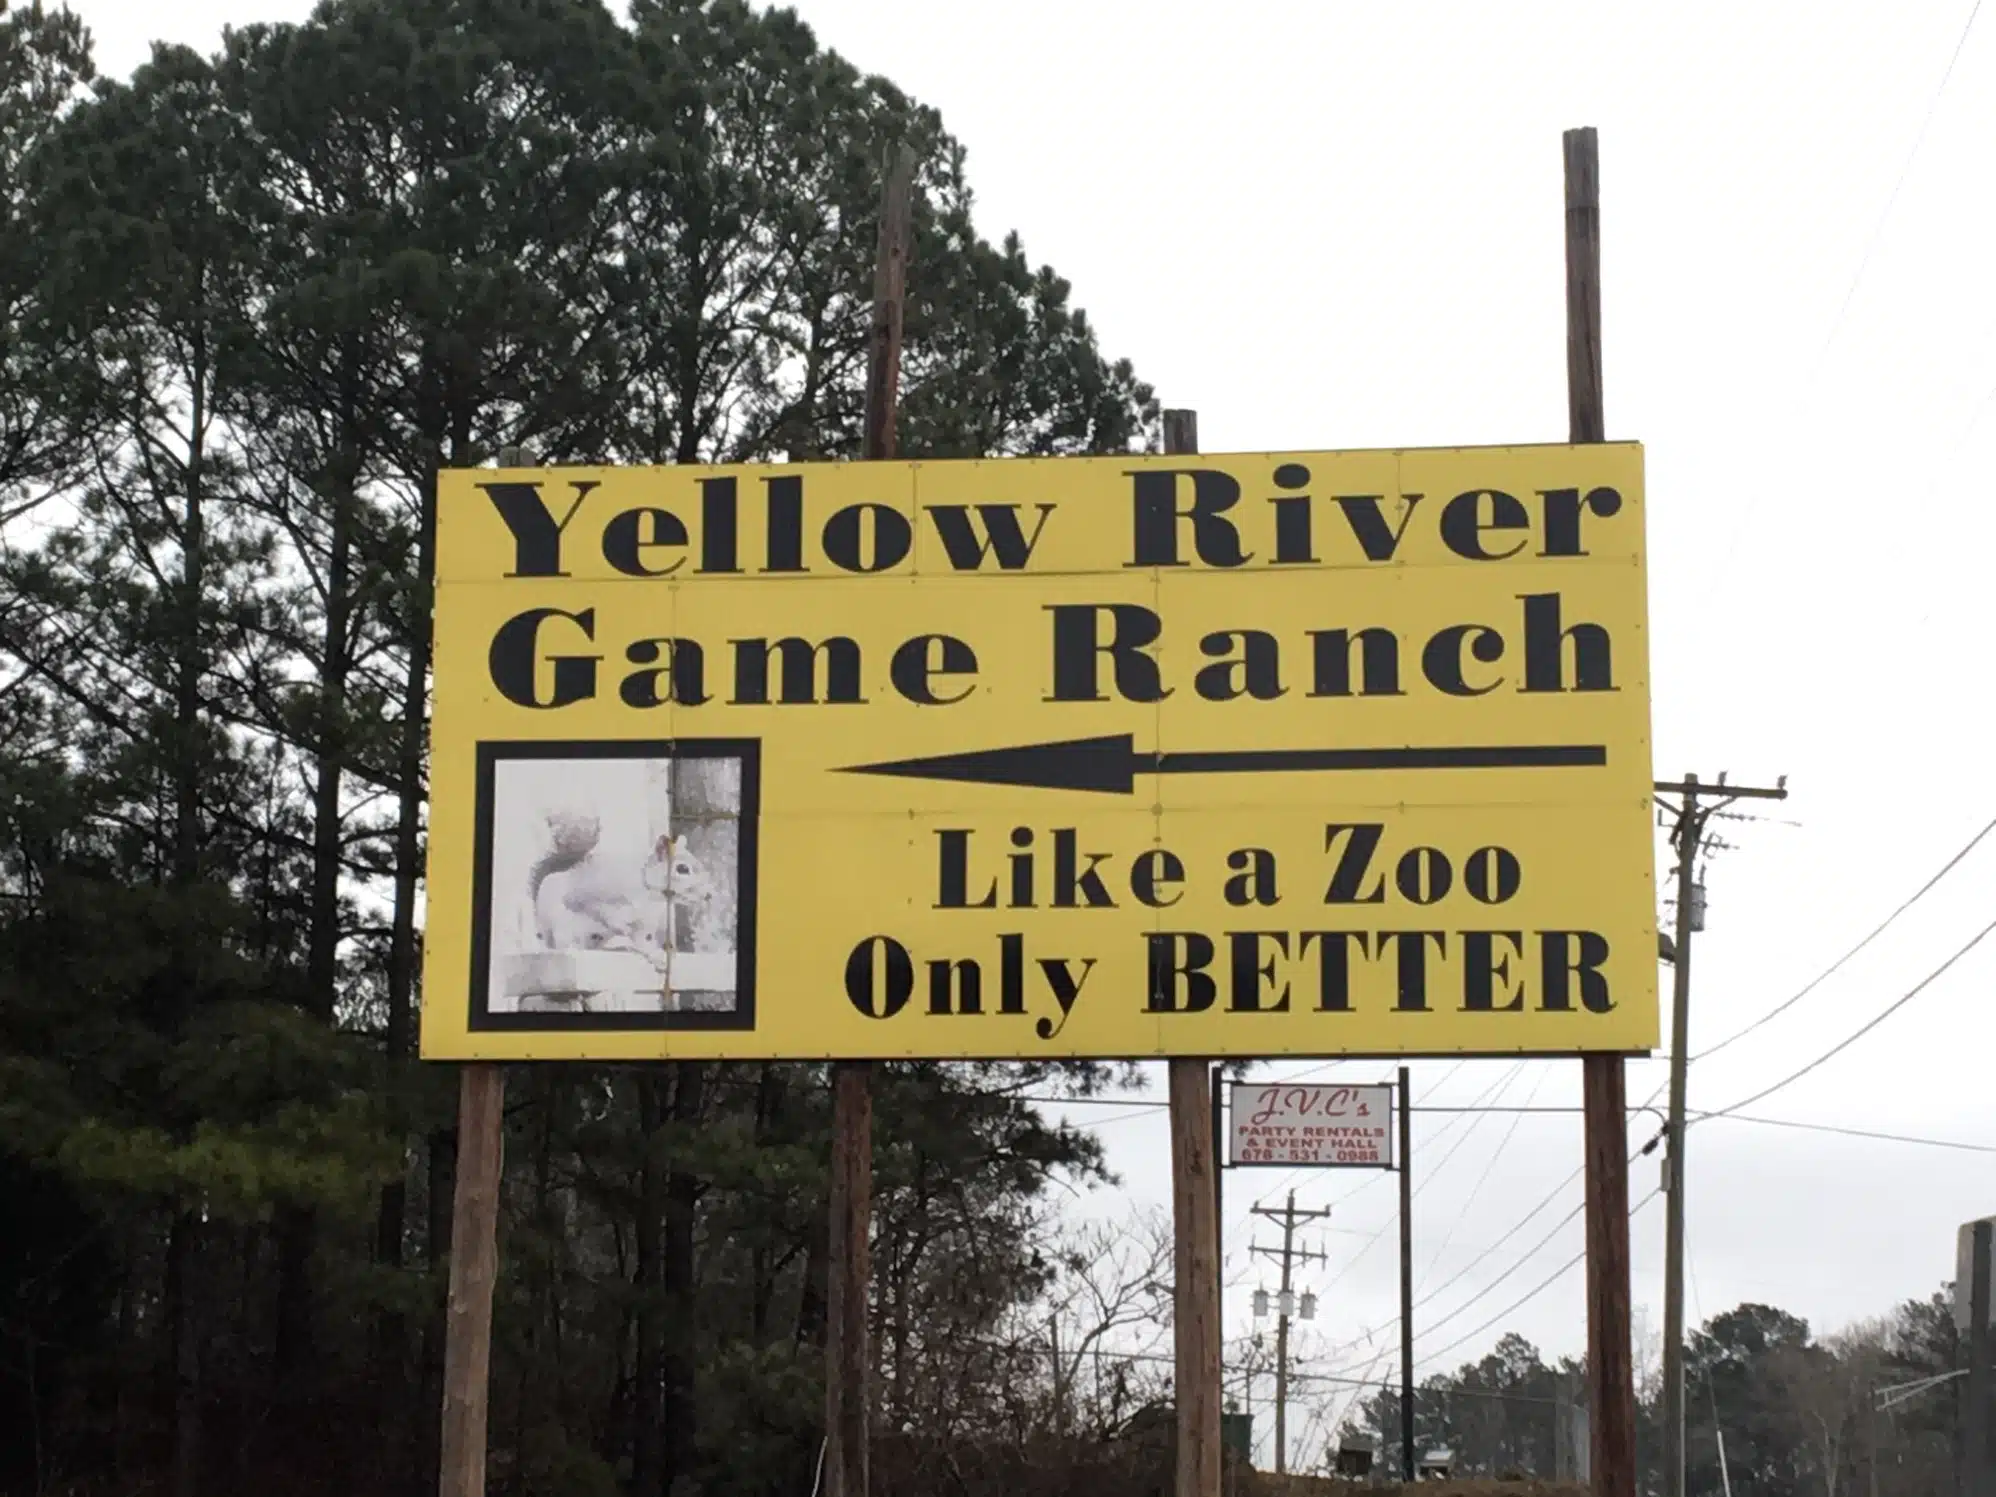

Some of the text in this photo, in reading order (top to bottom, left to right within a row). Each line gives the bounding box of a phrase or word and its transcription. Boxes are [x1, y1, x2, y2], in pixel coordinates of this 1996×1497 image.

[474, 463, 1622, 578] Yellow River
[488, 592, 1621, 709] Game Ranch
[932, 823, 1521, 909] Like a Zoo
[844, 930, 1617, 1040] Only BETTER
[1238, 1126, 1385, 1138] PARTY RENTALS
[1246, 1138, 1377, 1149] & EVENT HALL
